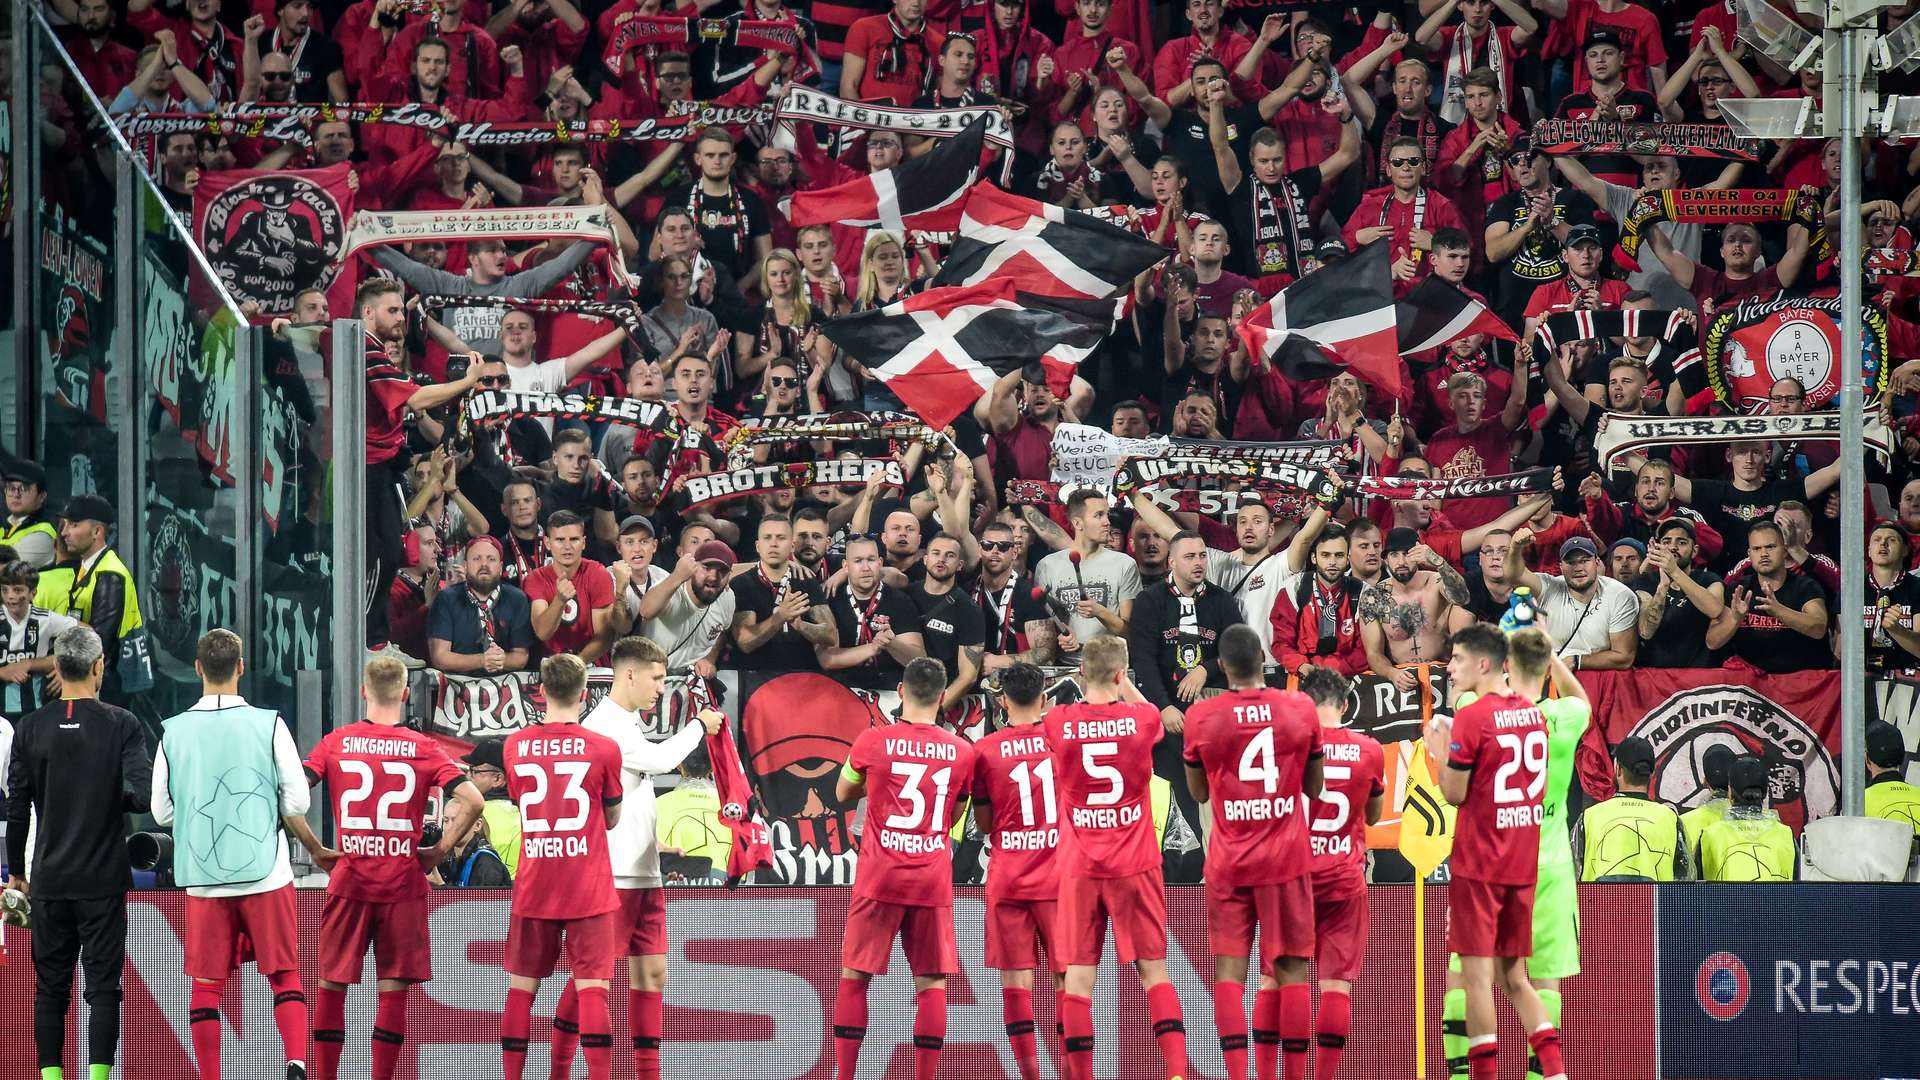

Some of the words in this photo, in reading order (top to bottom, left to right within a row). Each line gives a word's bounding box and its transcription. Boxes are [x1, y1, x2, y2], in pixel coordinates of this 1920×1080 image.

[570, 120, 586, 131] 20
[1681, 190, 1740, 201] BAYER
[1753, 190, 1777, 201] 04
[1675, 204, 1784, 217] LEVERKUSEN
[429, 219, 580, 233] LEVERKUSEN
[1260, 225, 1281, 240] 1904
[1300, 238, 1314, 252] 190
[1514, 262, 1562, 277] RACISM
[244, 274, 266, 284] von
[264, 280, 295, 292] 2010
[1778, 310, 1815, 323] BAYER
[1779, 351, 1820, 363] BAYER
[469, 390, 586, 421] ULTRAS
[598, 395, 664, 427] LEV
[1056, 428, 1107, 443] Mitch
[1628, 417, 1768, 438] ULTRAS
[1051, 442, 1108, 456] Weiser
[684, 465, 779, 503] BROT
[1261, 461, 1318, 490] LEV
[1233, 703, 1272, 724] TAH
[1078, 717, 1137, 738] BENDER
[342, 736, 417, 758] SINKGRAVEN
[517, 738, 586, 758] WEISER
[885, 738, 957, 762] VOLLAND
[1001, 736, 1047, 759] AMIR
[1238, 726, 1279, 794] 4
[1493, 731, 1549, 804] 29
[1081, 742, 1125, 805] 5
[338, 760, 417, 831] 22
[513, 761, 592, 833] 23
[884, 761, 952, 832] 31
[1008, 757, 1057, 827] 11
[1073, 807, 1118, 829] BAYER
[1120, 804, 1142, 824] 04
[1224, 798, 1271, 822] BAYER
[1273, 795, 1295, 818] 04
[1496, 805, 1532, 830] BAYER
[341, 834, 386, 856] BAYER
[390, 836, 411, 858] 04
[524, 836, 561, 859] BAYER
[566, 836, 588, 858] 04
[880, 829, 923, 854] BAYER
[922, 834, 946, 853] 04
[1001, 829, 1043, 850] BAYER
[1328, 834, 1351, 855] 04
